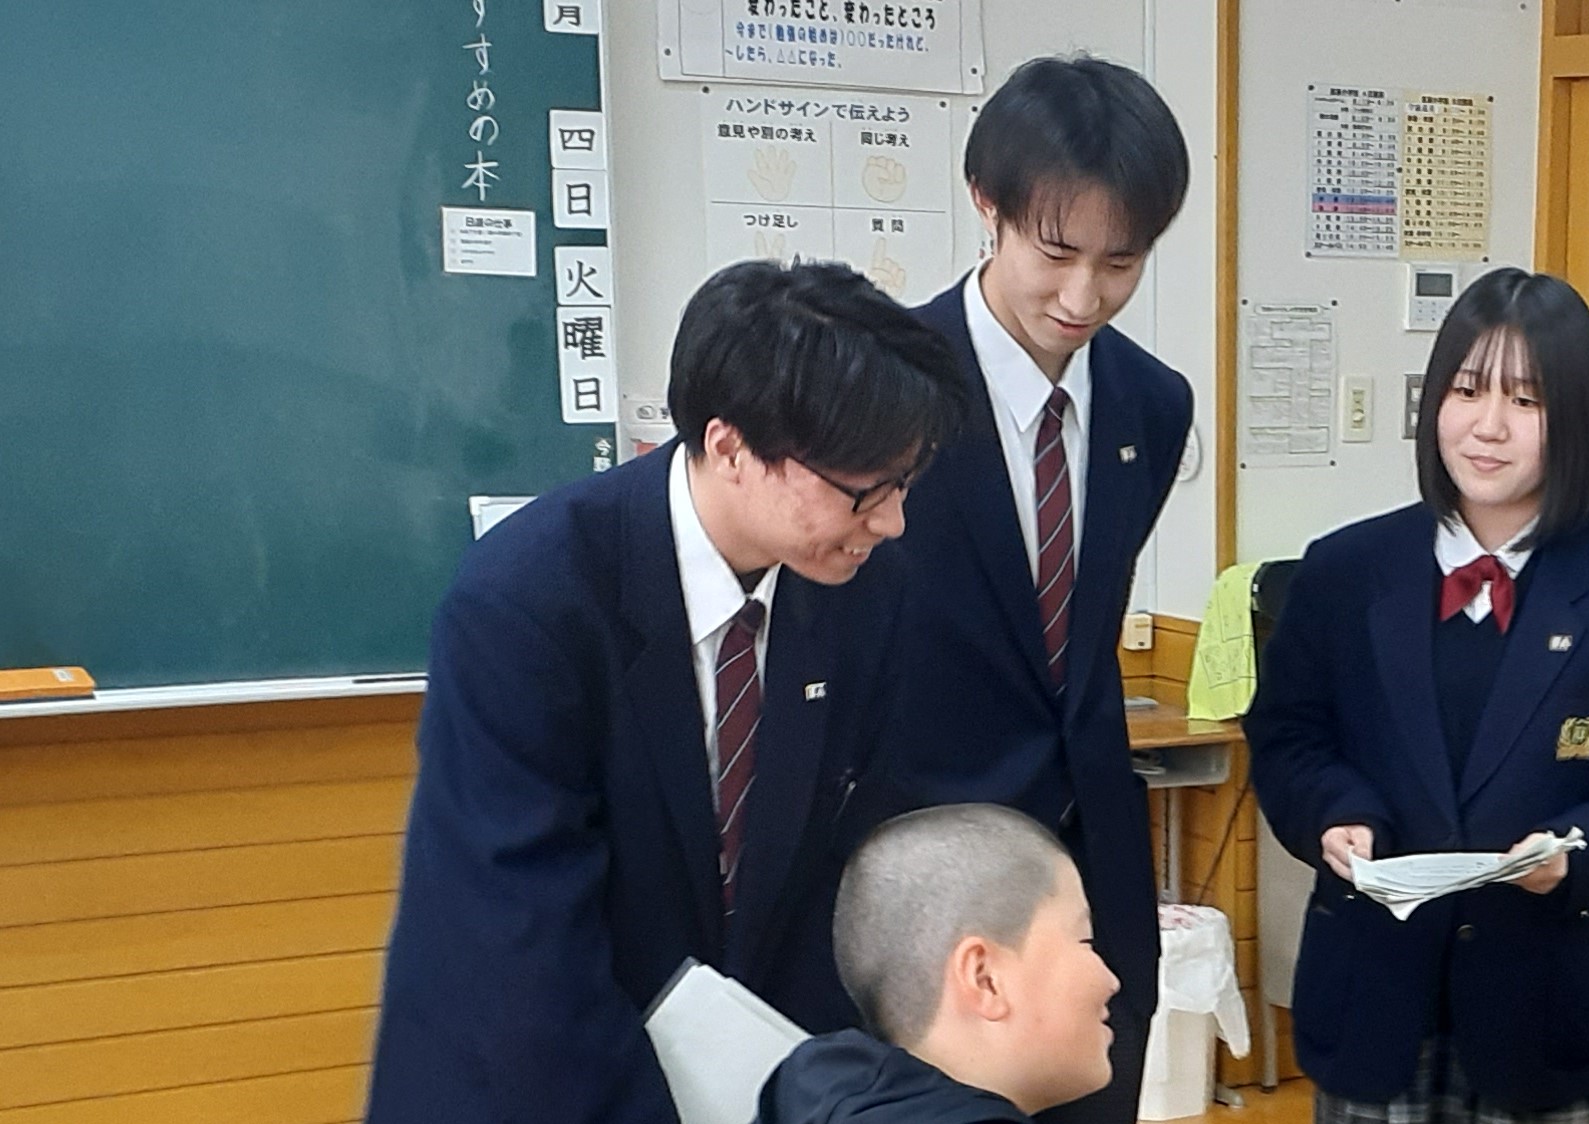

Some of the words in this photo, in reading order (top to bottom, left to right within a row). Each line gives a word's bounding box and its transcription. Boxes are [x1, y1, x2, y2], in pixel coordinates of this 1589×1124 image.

[726, 98, 911, 123] ハンドサインで伝えよう
[717, 123, 817, 143] 意見や別の考え
[860, 131, 911, 148] 同じ考え
[743, 213, 799, 229] つけ足し
[562, 259, 606, 411] 火曜日
